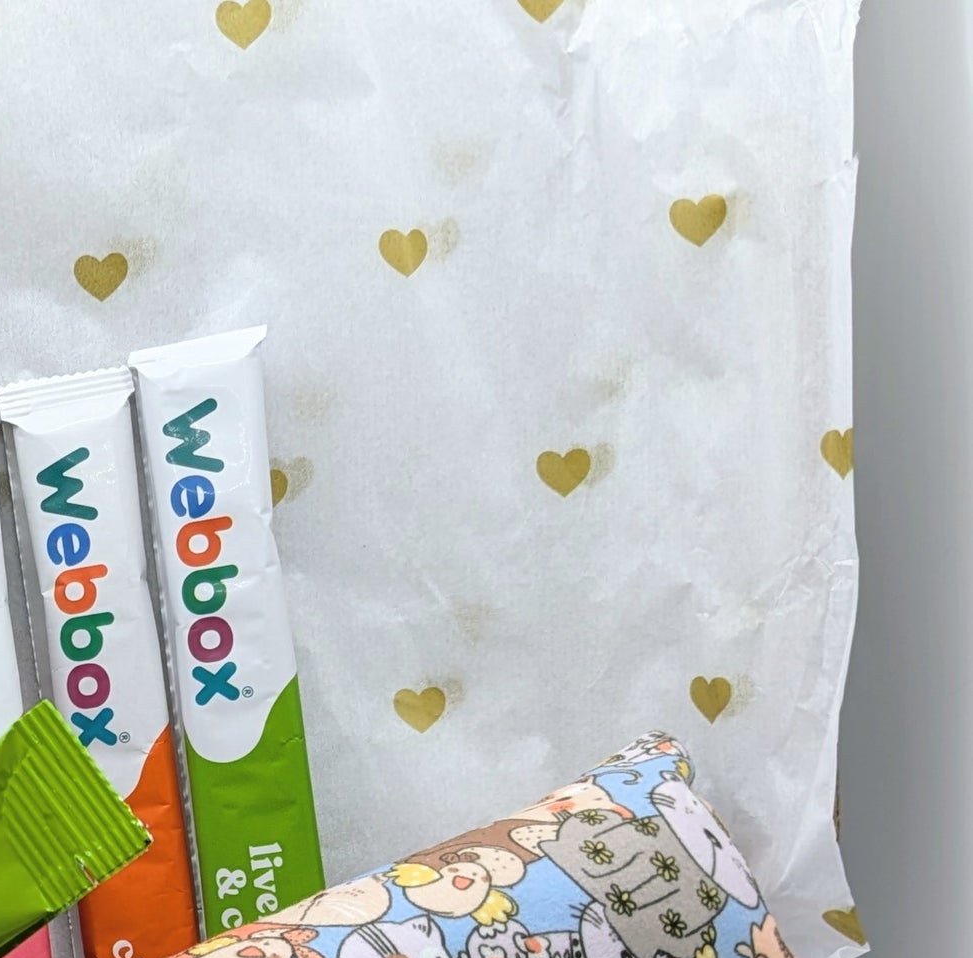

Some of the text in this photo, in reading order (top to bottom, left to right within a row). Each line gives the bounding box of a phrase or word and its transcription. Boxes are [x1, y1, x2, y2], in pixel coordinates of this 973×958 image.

[36, 446, 118, 747] Webbox
[163, 398, 241, 706] Webbox
[249, 842, 282, 920] live
